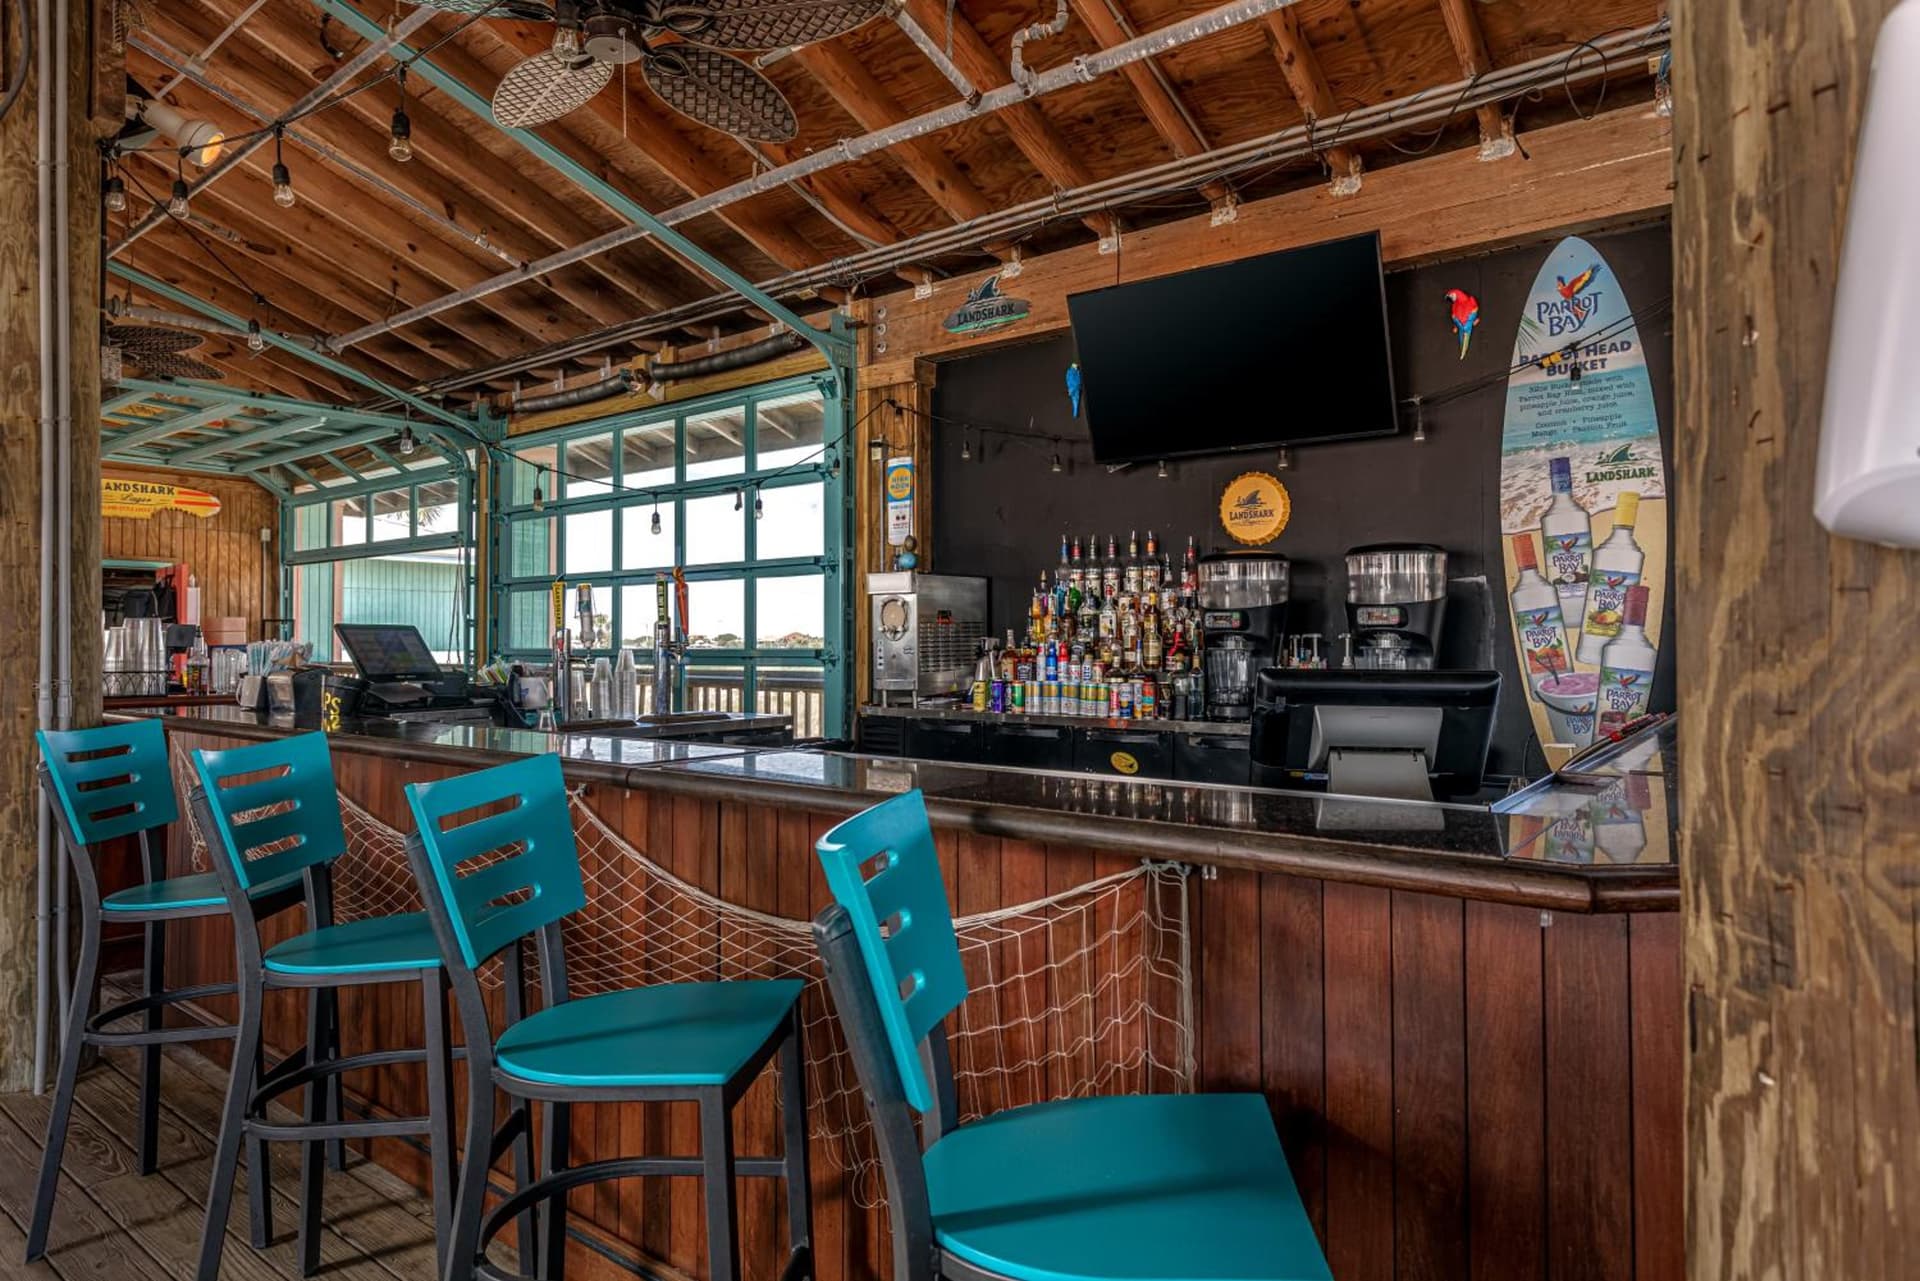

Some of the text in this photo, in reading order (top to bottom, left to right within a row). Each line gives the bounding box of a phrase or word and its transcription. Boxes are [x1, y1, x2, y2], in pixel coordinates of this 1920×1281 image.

[956, 303, 1015, 324] LANDSHARK
[1536, 291, 1603, 324] PARROT
[1549, 309, 1591, 336] BAY
[1519, 340, 1632, 367] PAOT HEAD
[1585, 466, 1656, 483] LANDSHARK
[104, 482, 175, 495] ANDSHARK
[1229, 508, 1275, 521] LANDSHARK
[1552, 552, 1585, 567] PARROT
[1559, 561, 1580, 574] BAY
[1594, 588, 1625, 602] PARRO
[1599, 599, 1622, 611] BAY
[1525, 626, 1557, 642] PARROT
[1533, 635, 1553, 648] BAY
[1606, 687, 1643, 705] PARROT
[1611, 698, 1636, 712] BAY
